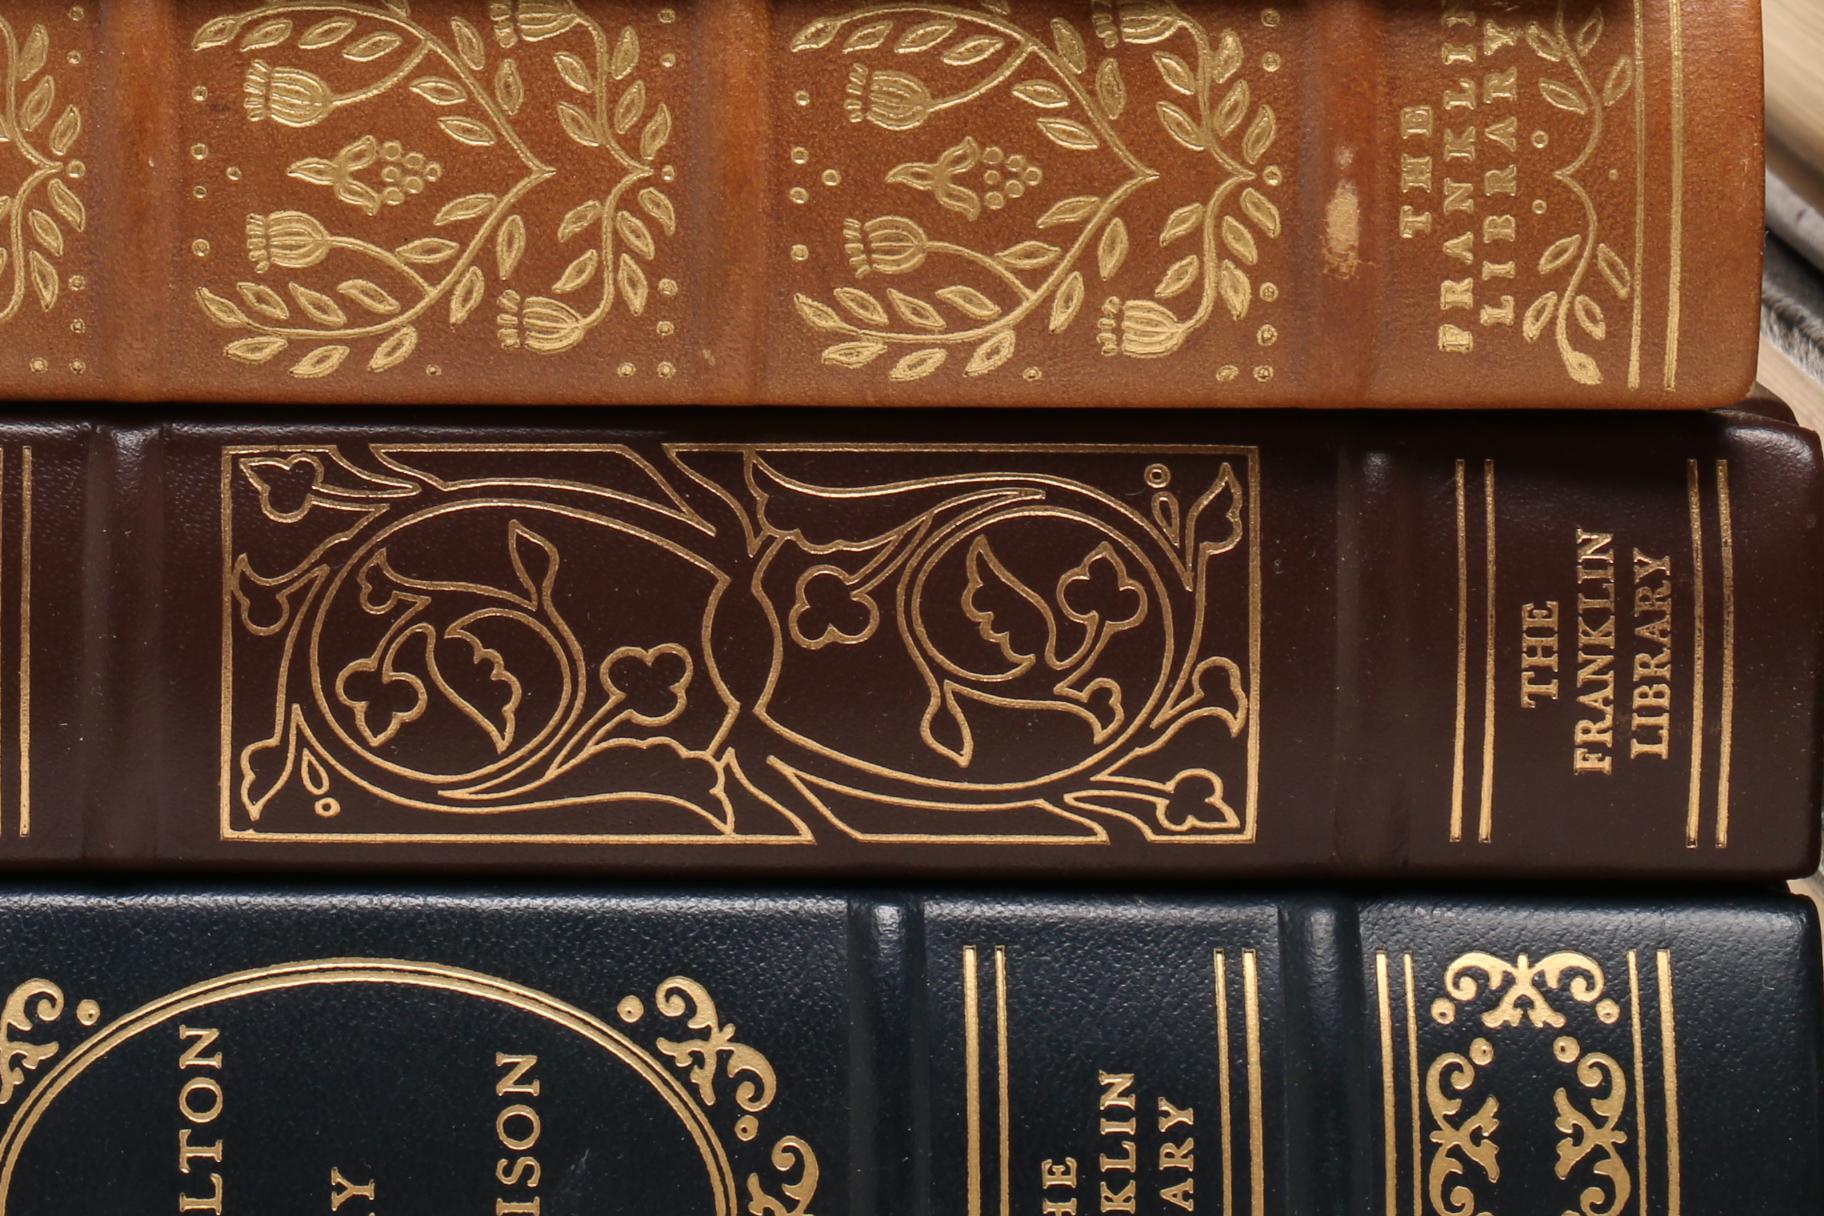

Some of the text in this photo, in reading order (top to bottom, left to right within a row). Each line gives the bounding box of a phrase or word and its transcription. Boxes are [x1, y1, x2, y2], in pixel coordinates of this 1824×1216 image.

[1399, 105, 1433, 239] THE
[1480, 19, 1519, 326] LIBRARY
[1520, 600, 1559, 709] THE
[1573, 528, 1615, 776] FRANKLIN
[1630, 547, 1672, 761] LIBRARY
[179, 1025, 223, 1216] LTON
[1159, 1096, 1194, 1212] ARY
